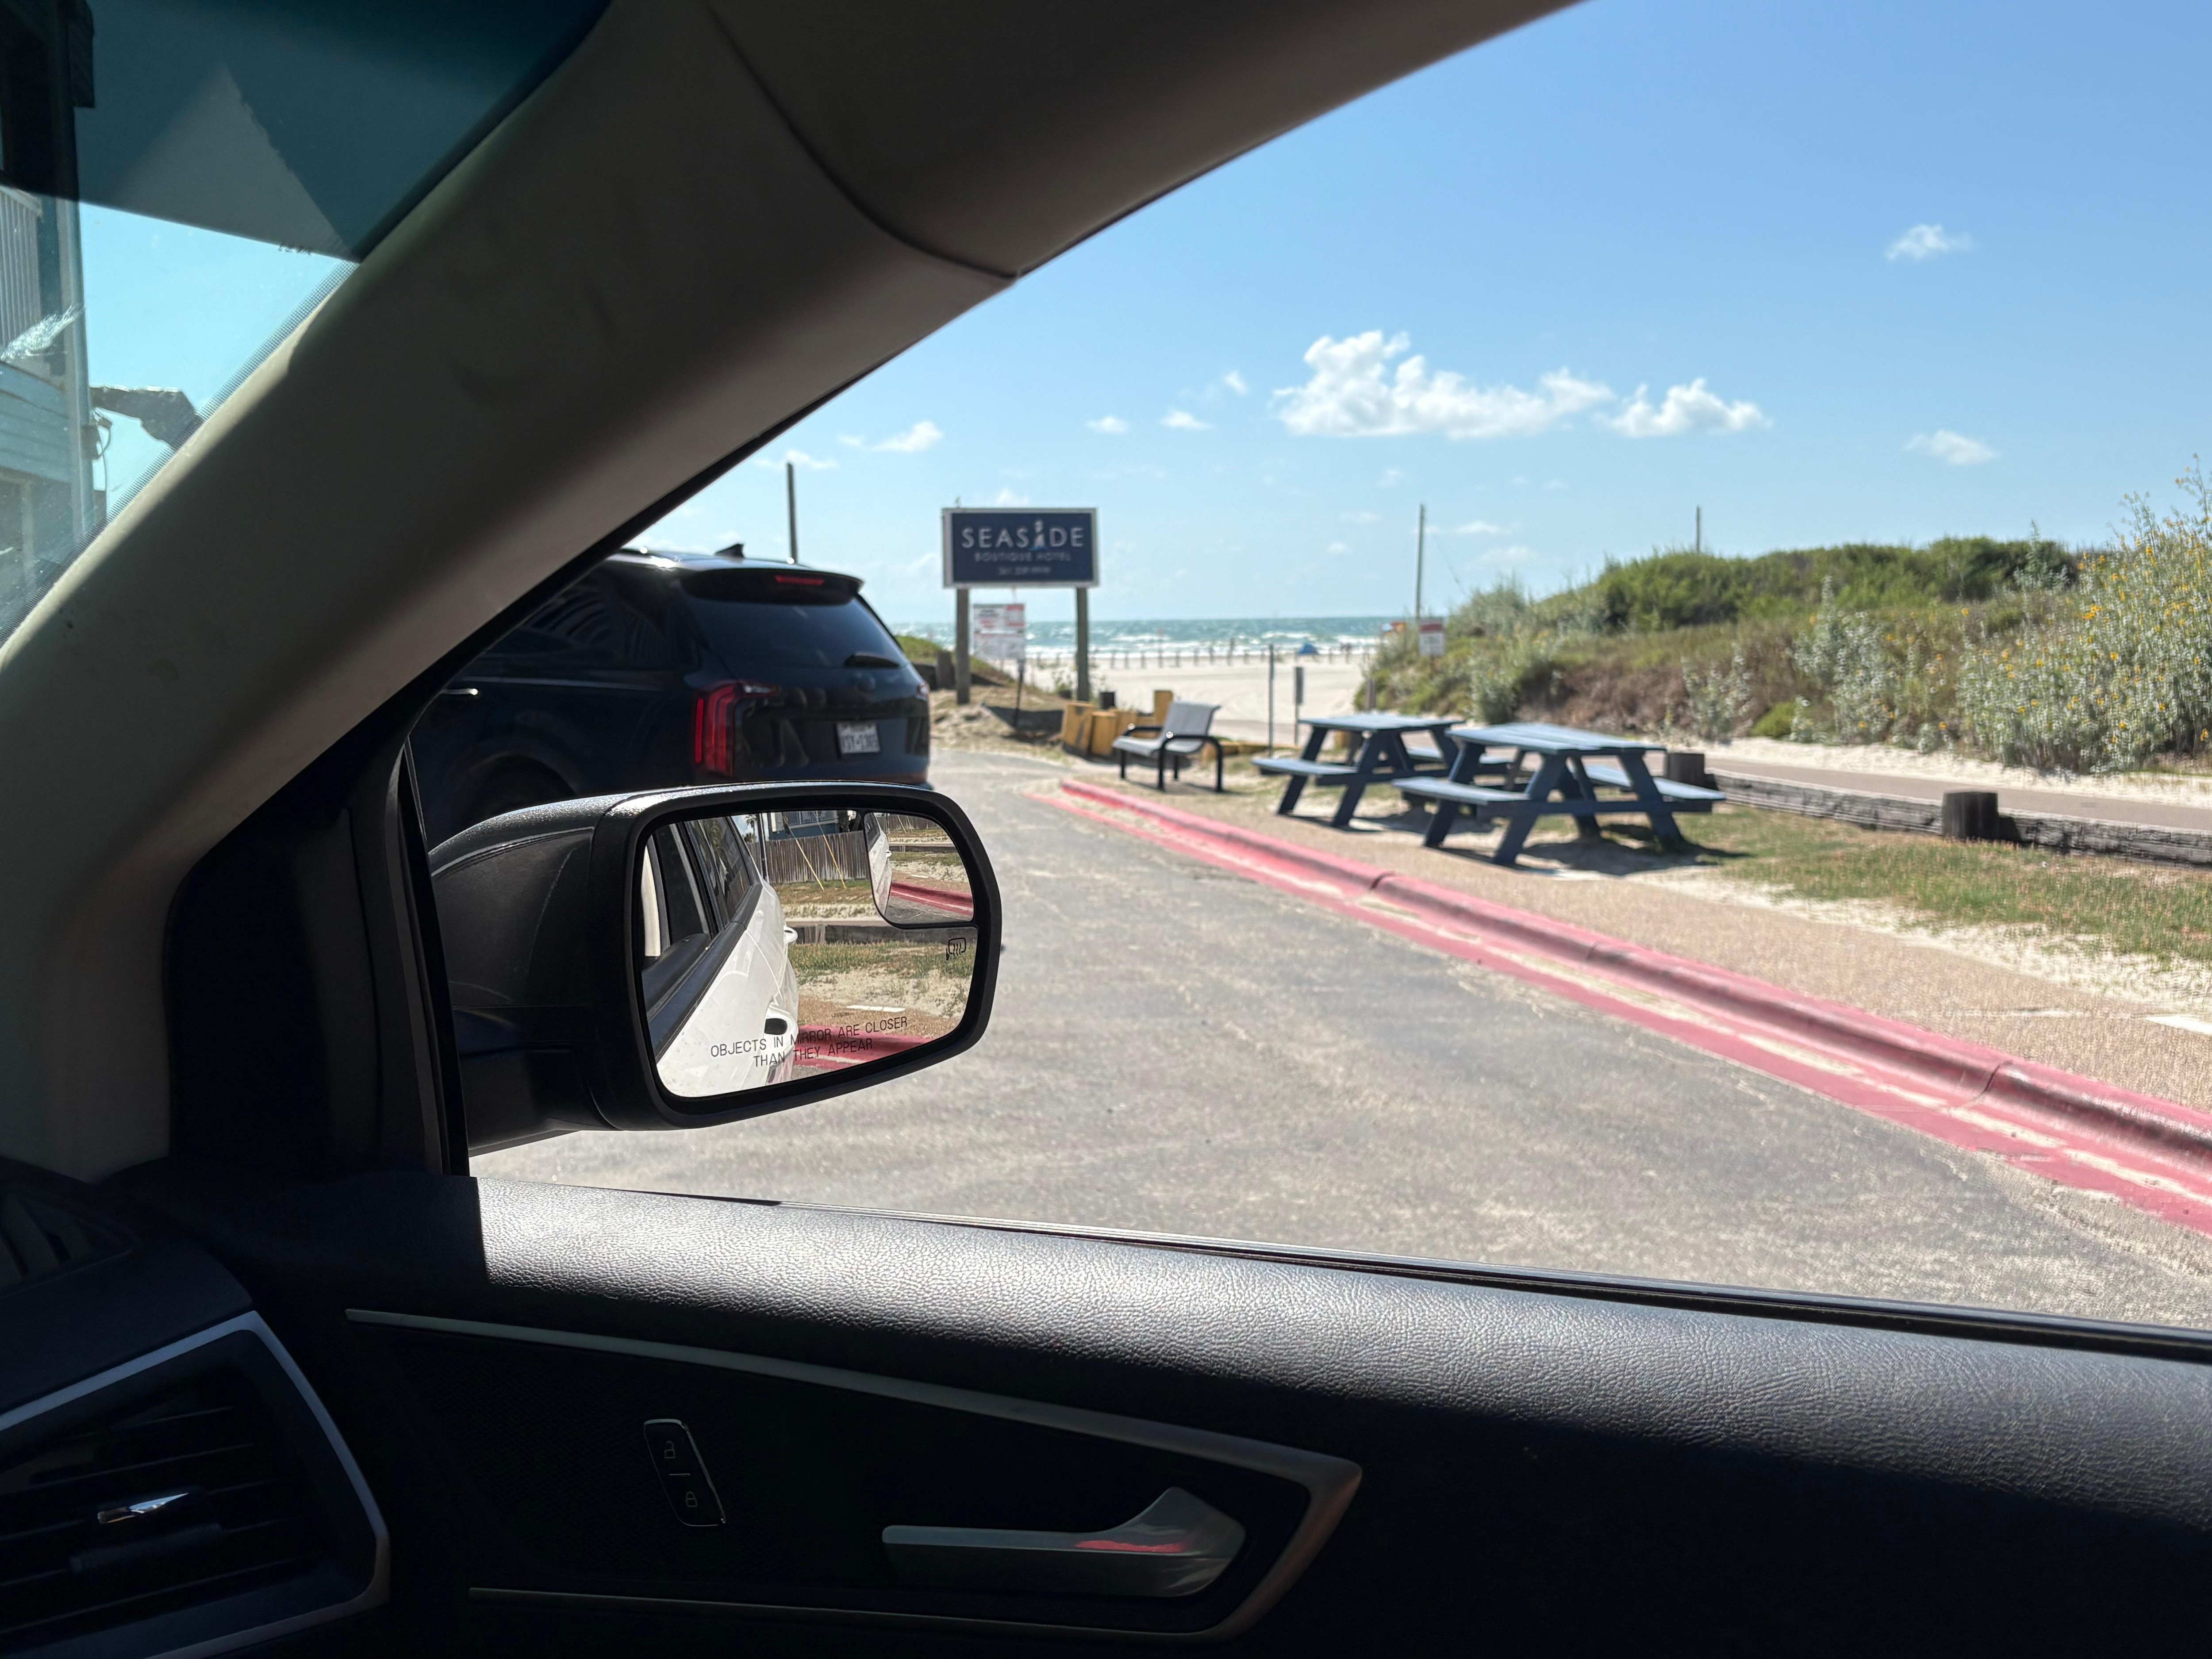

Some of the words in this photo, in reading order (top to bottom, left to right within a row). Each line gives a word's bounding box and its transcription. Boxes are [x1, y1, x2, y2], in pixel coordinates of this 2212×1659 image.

[961, 519, 1084, 549] SEASIDE
[975, 552, 1032, 562] BOUTIQUE
[1036, 552, 1071, 561] HOTEL
[710, 1038, 767, 1058] OBJECTS
[773, 1036, 783, 1048] IN
[790, 1028, 832, 1046] MIRROR
[839, 1024, 860, 1038] ARE
[865, 1016, 907, 1034] CLOSER
[753, 1051, 785, 1068] THAN
[794, 1045, 819, 1062] THEY
[828, 1038, 872, 1056] APPEAR
